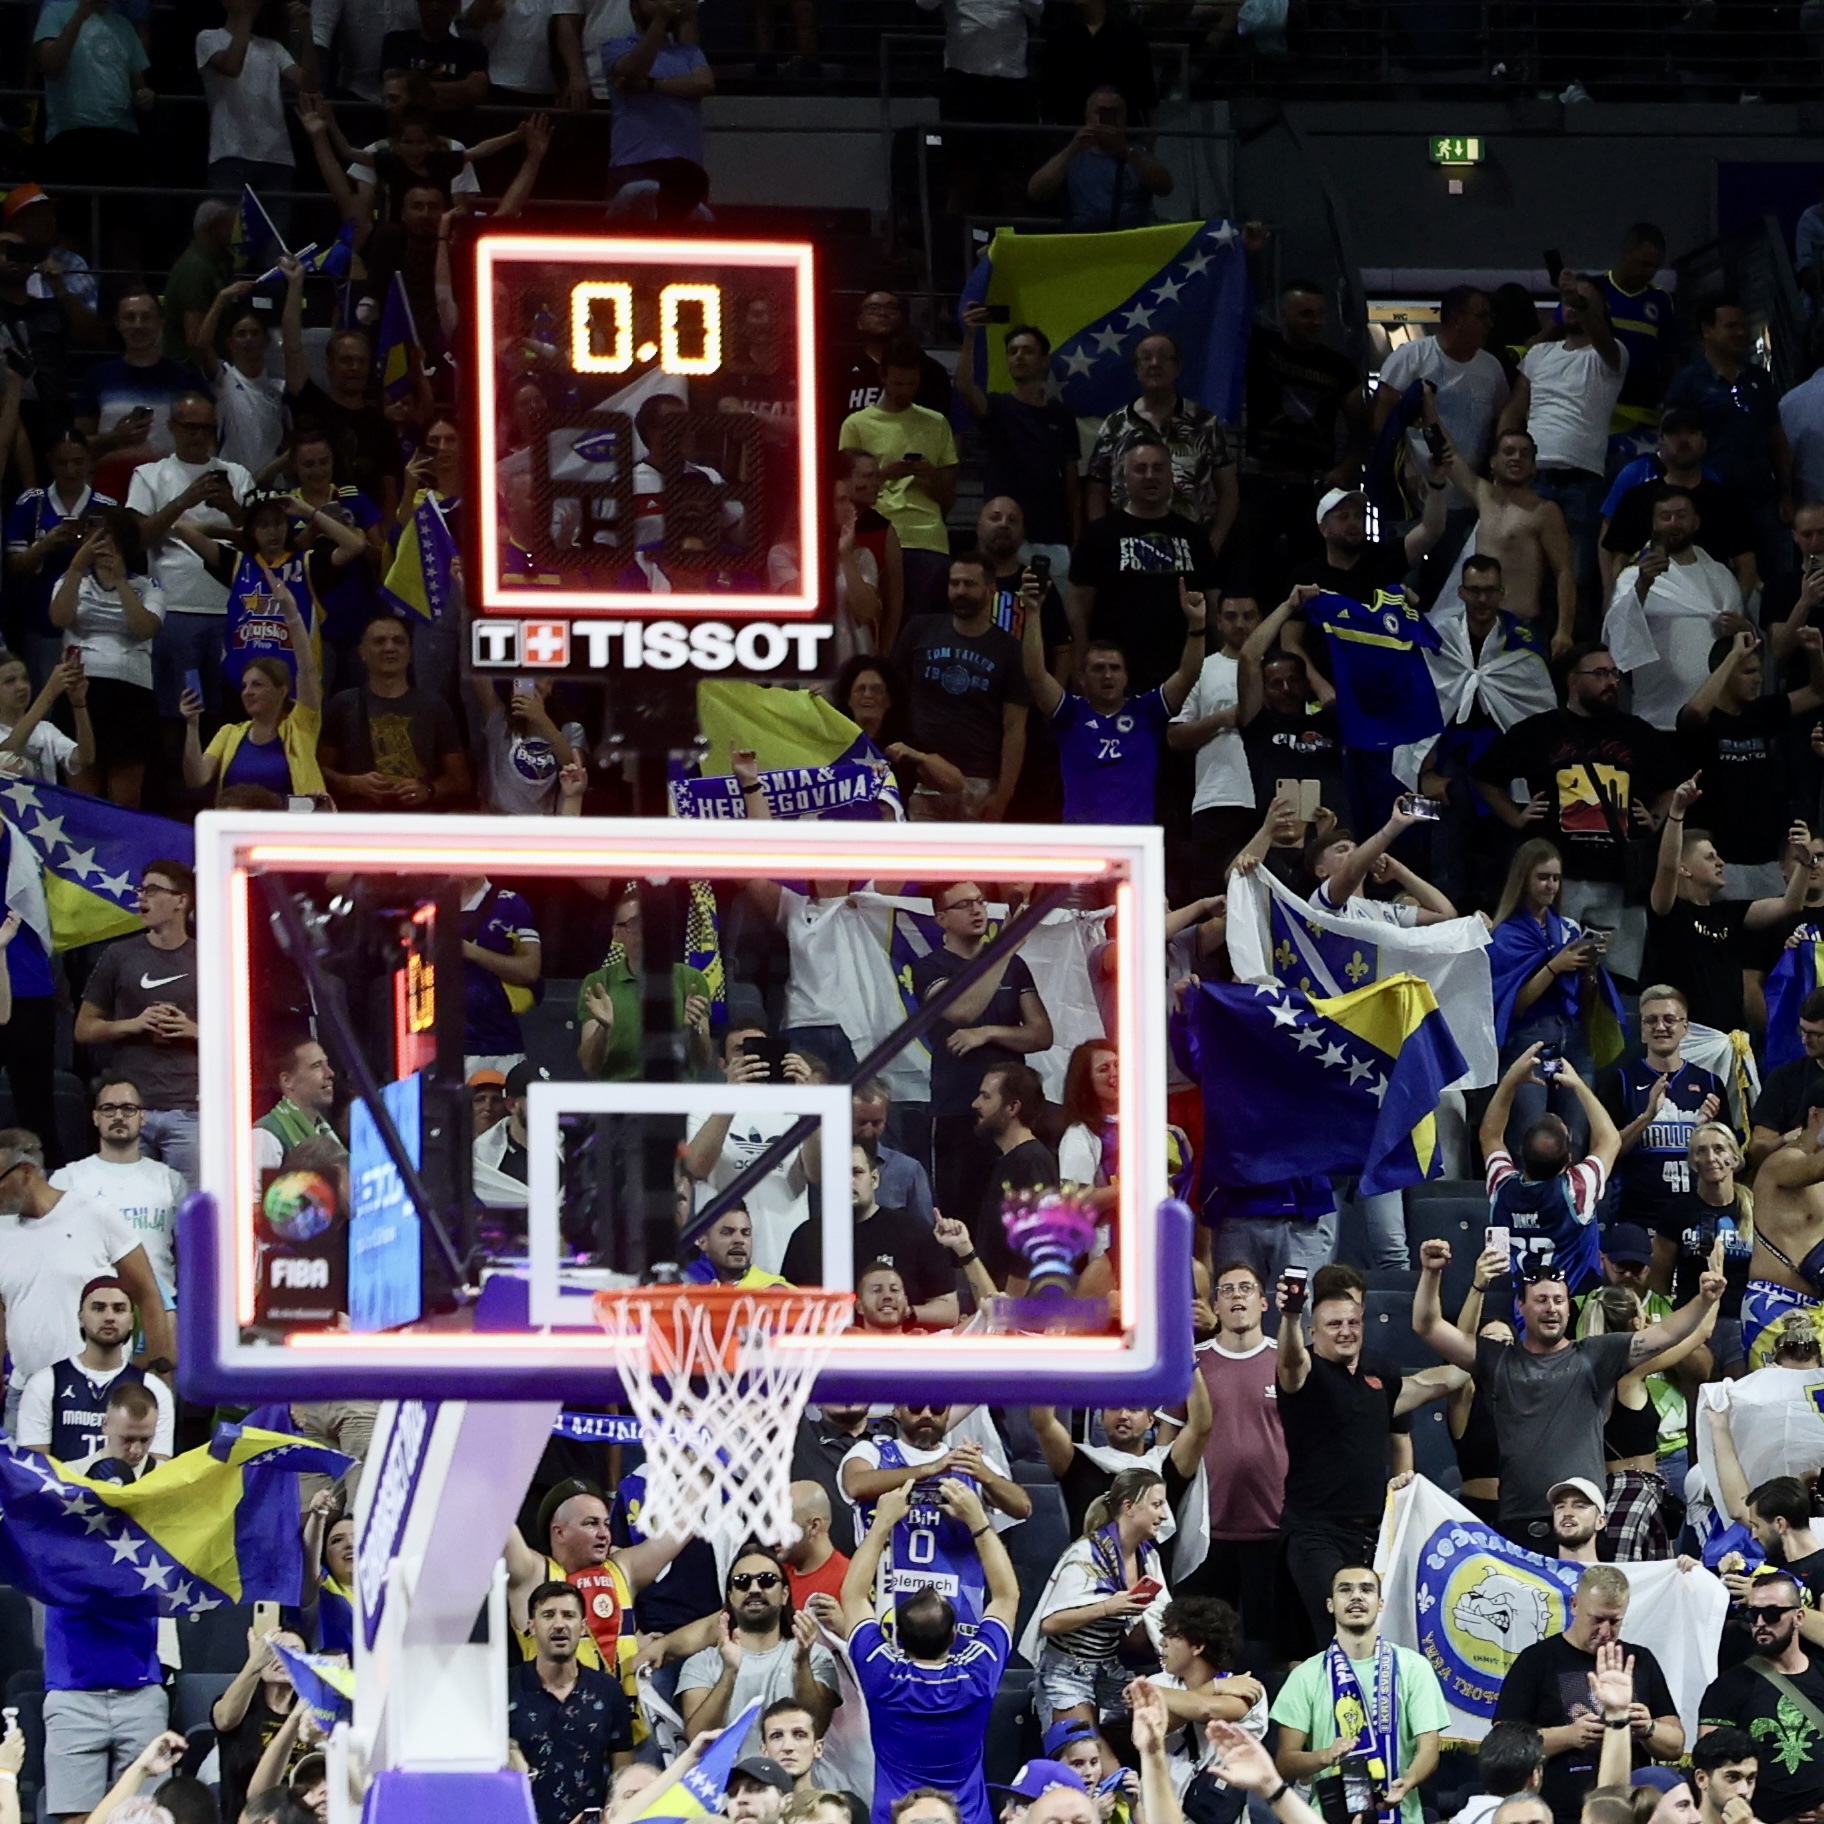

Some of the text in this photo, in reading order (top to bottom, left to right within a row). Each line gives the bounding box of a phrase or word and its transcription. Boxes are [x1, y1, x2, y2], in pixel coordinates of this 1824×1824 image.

[570, 281, 722, 376] 0.0
[849, 386, 885, 408] HEA
[576, 621, 834, 670] TISSOT
[697, 776, 867, 820] HEREGOVINA
[725, 767, 832, 799] BSNIA &
[1641, 1122, 1698, 1151] DALLA
[1663, 1161, 1689, 1193] 41
[271, 1257, 330, 1290] FIBA
[62, 1409, 107, 1428] MAVER
[909, 1506, 940, 1527] BiH
